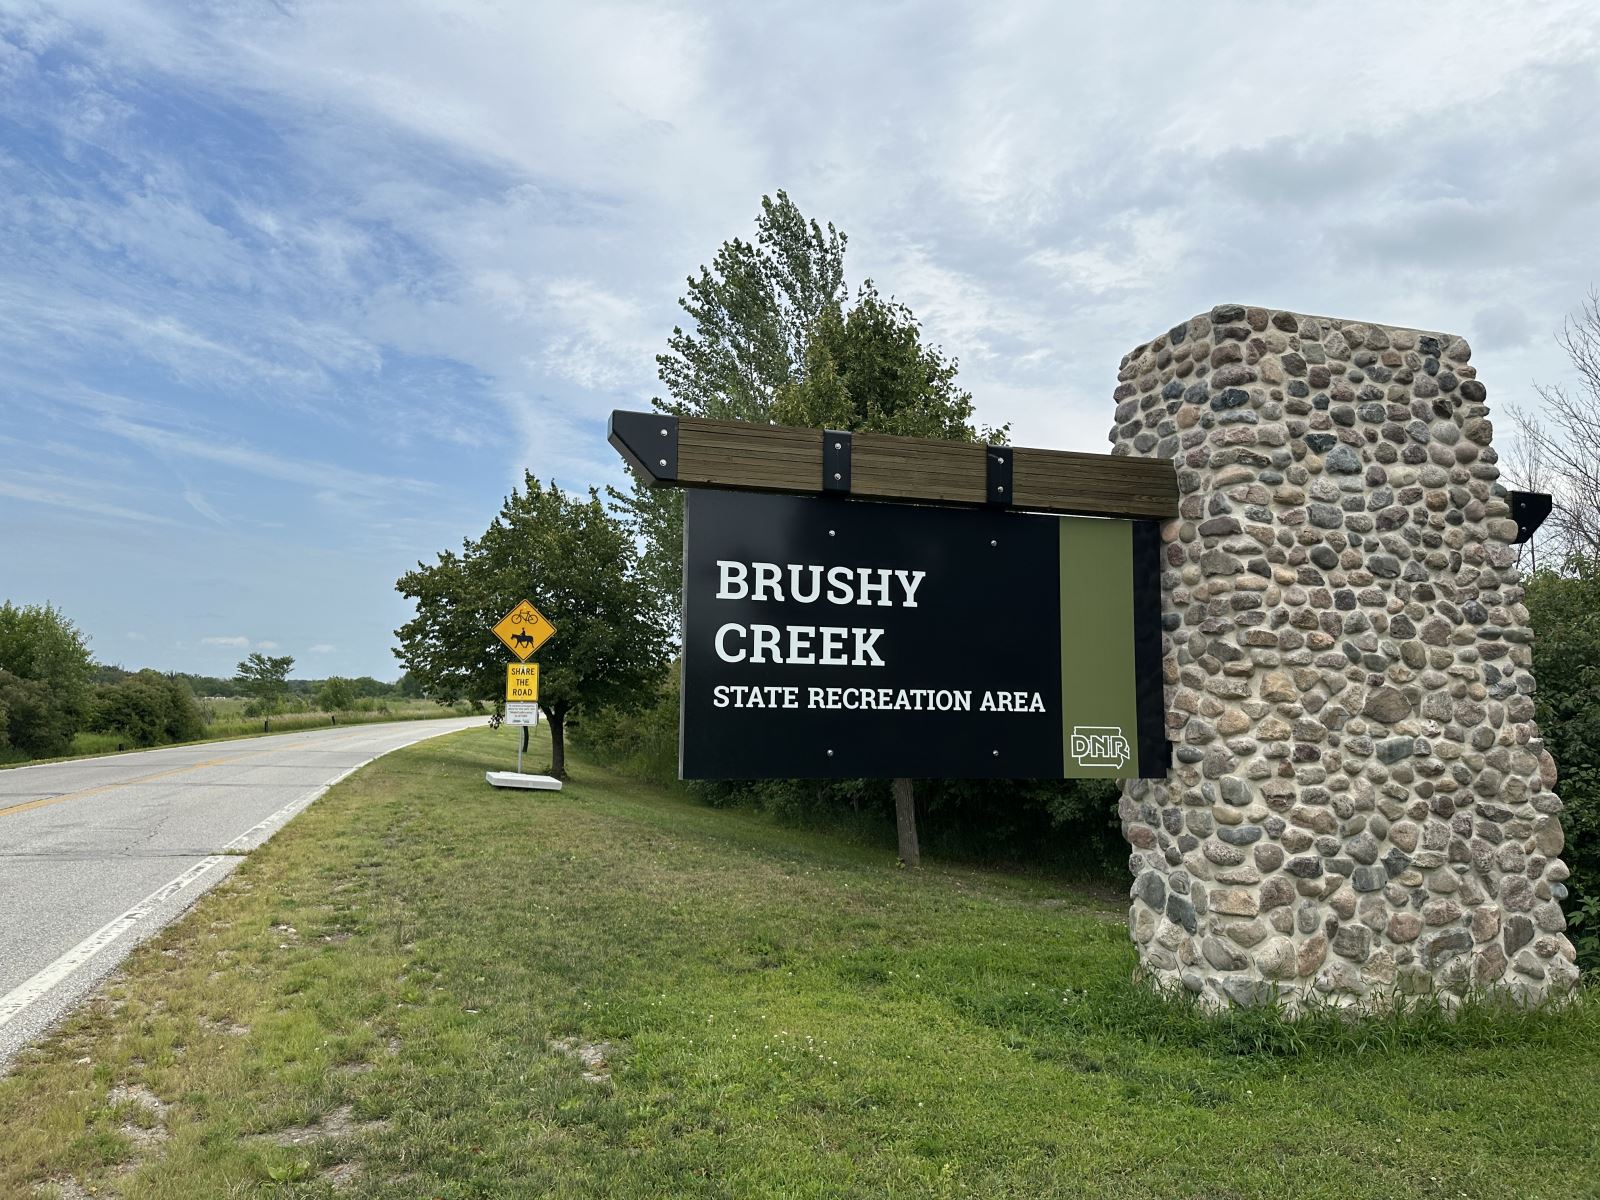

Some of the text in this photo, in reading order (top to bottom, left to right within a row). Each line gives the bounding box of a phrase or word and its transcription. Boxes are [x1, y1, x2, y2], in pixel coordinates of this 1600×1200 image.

[716, 560, 926, 608] BRUSHY
[714, 622, 886, 667] CREEK
[511, 668, 535, 676] SHARE
[512, 688, 533, 696] ROAD
[713, 685, 1046, 713] STATE RECREATION AREA
[1071, 735, 1130, 760] DNR
